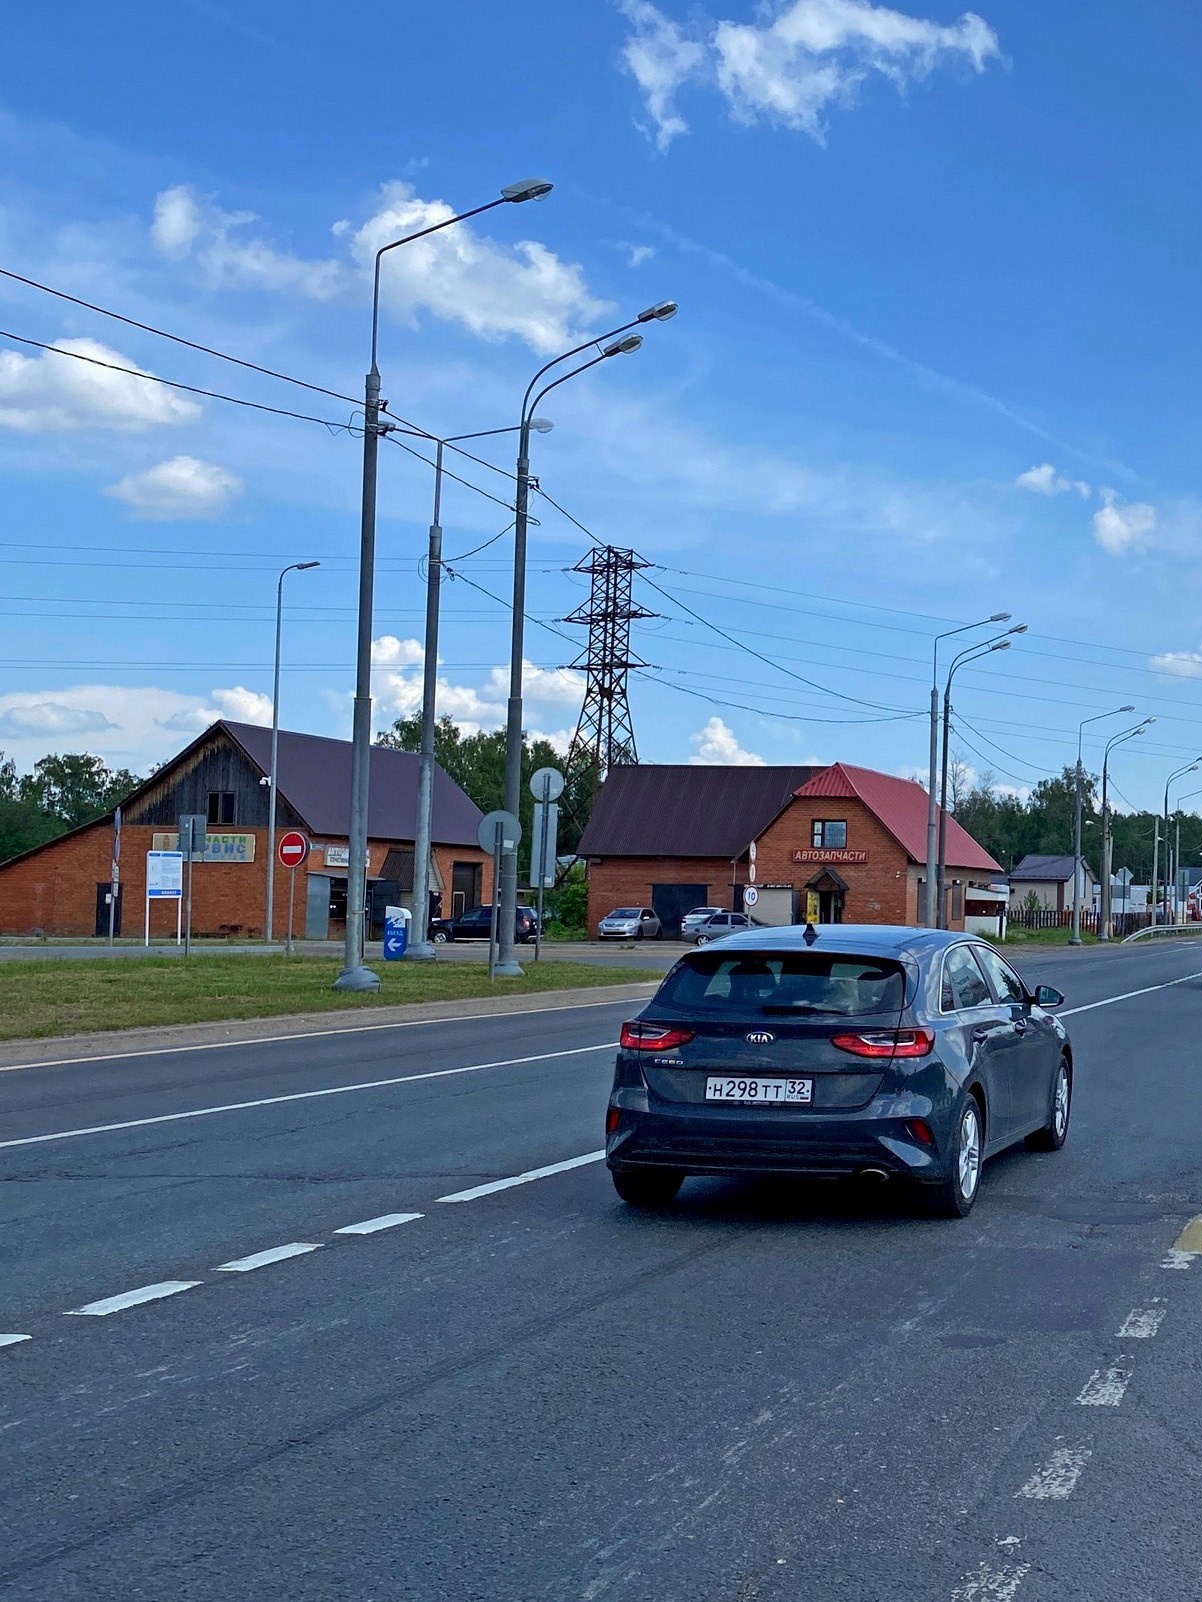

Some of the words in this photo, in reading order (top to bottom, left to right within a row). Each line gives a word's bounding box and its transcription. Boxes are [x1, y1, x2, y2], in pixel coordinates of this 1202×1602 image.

[795, 850, 866, 861] АВТОЗАПЧАСТИ
[748, 891, 756, 901] 10
[750, 1034, 768, 1043] KIA
[788, 1081, 806, 1095] 32
